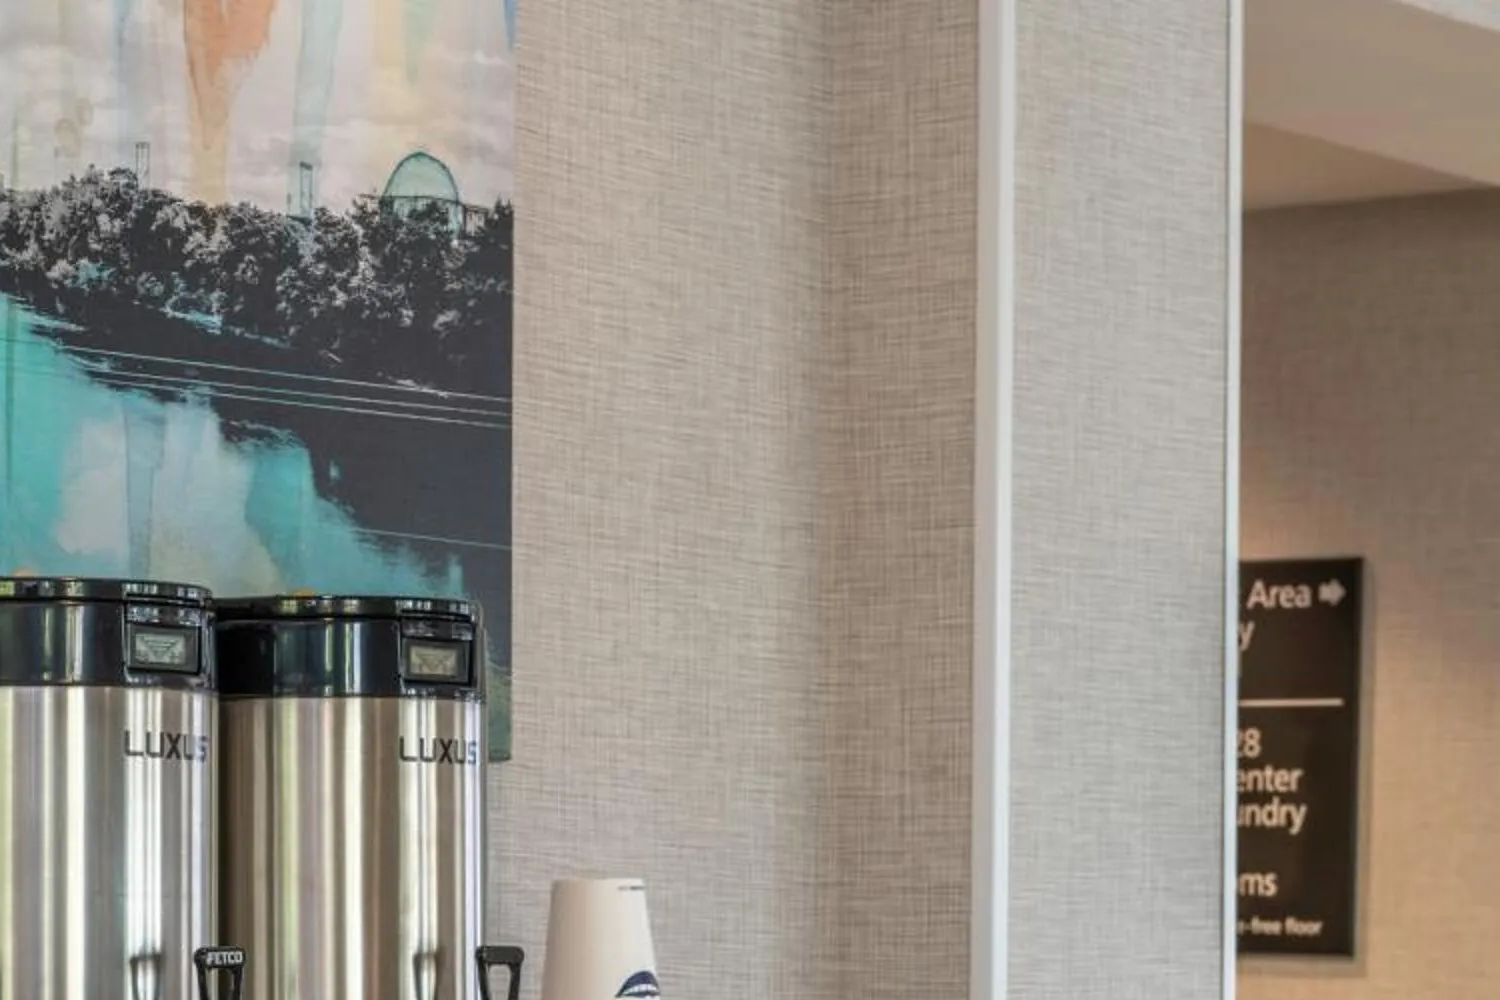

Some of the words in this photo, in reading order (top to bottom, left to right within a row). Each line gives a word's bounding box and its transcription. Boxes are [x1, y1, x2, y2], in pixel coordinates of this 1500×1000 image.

[1246, 579, 1312, 609] Area
[123, 729, 208, 762] LUXUS
[399, 735, 477, 765] LUXUS
[207, 951, 243, 965] FETCO
